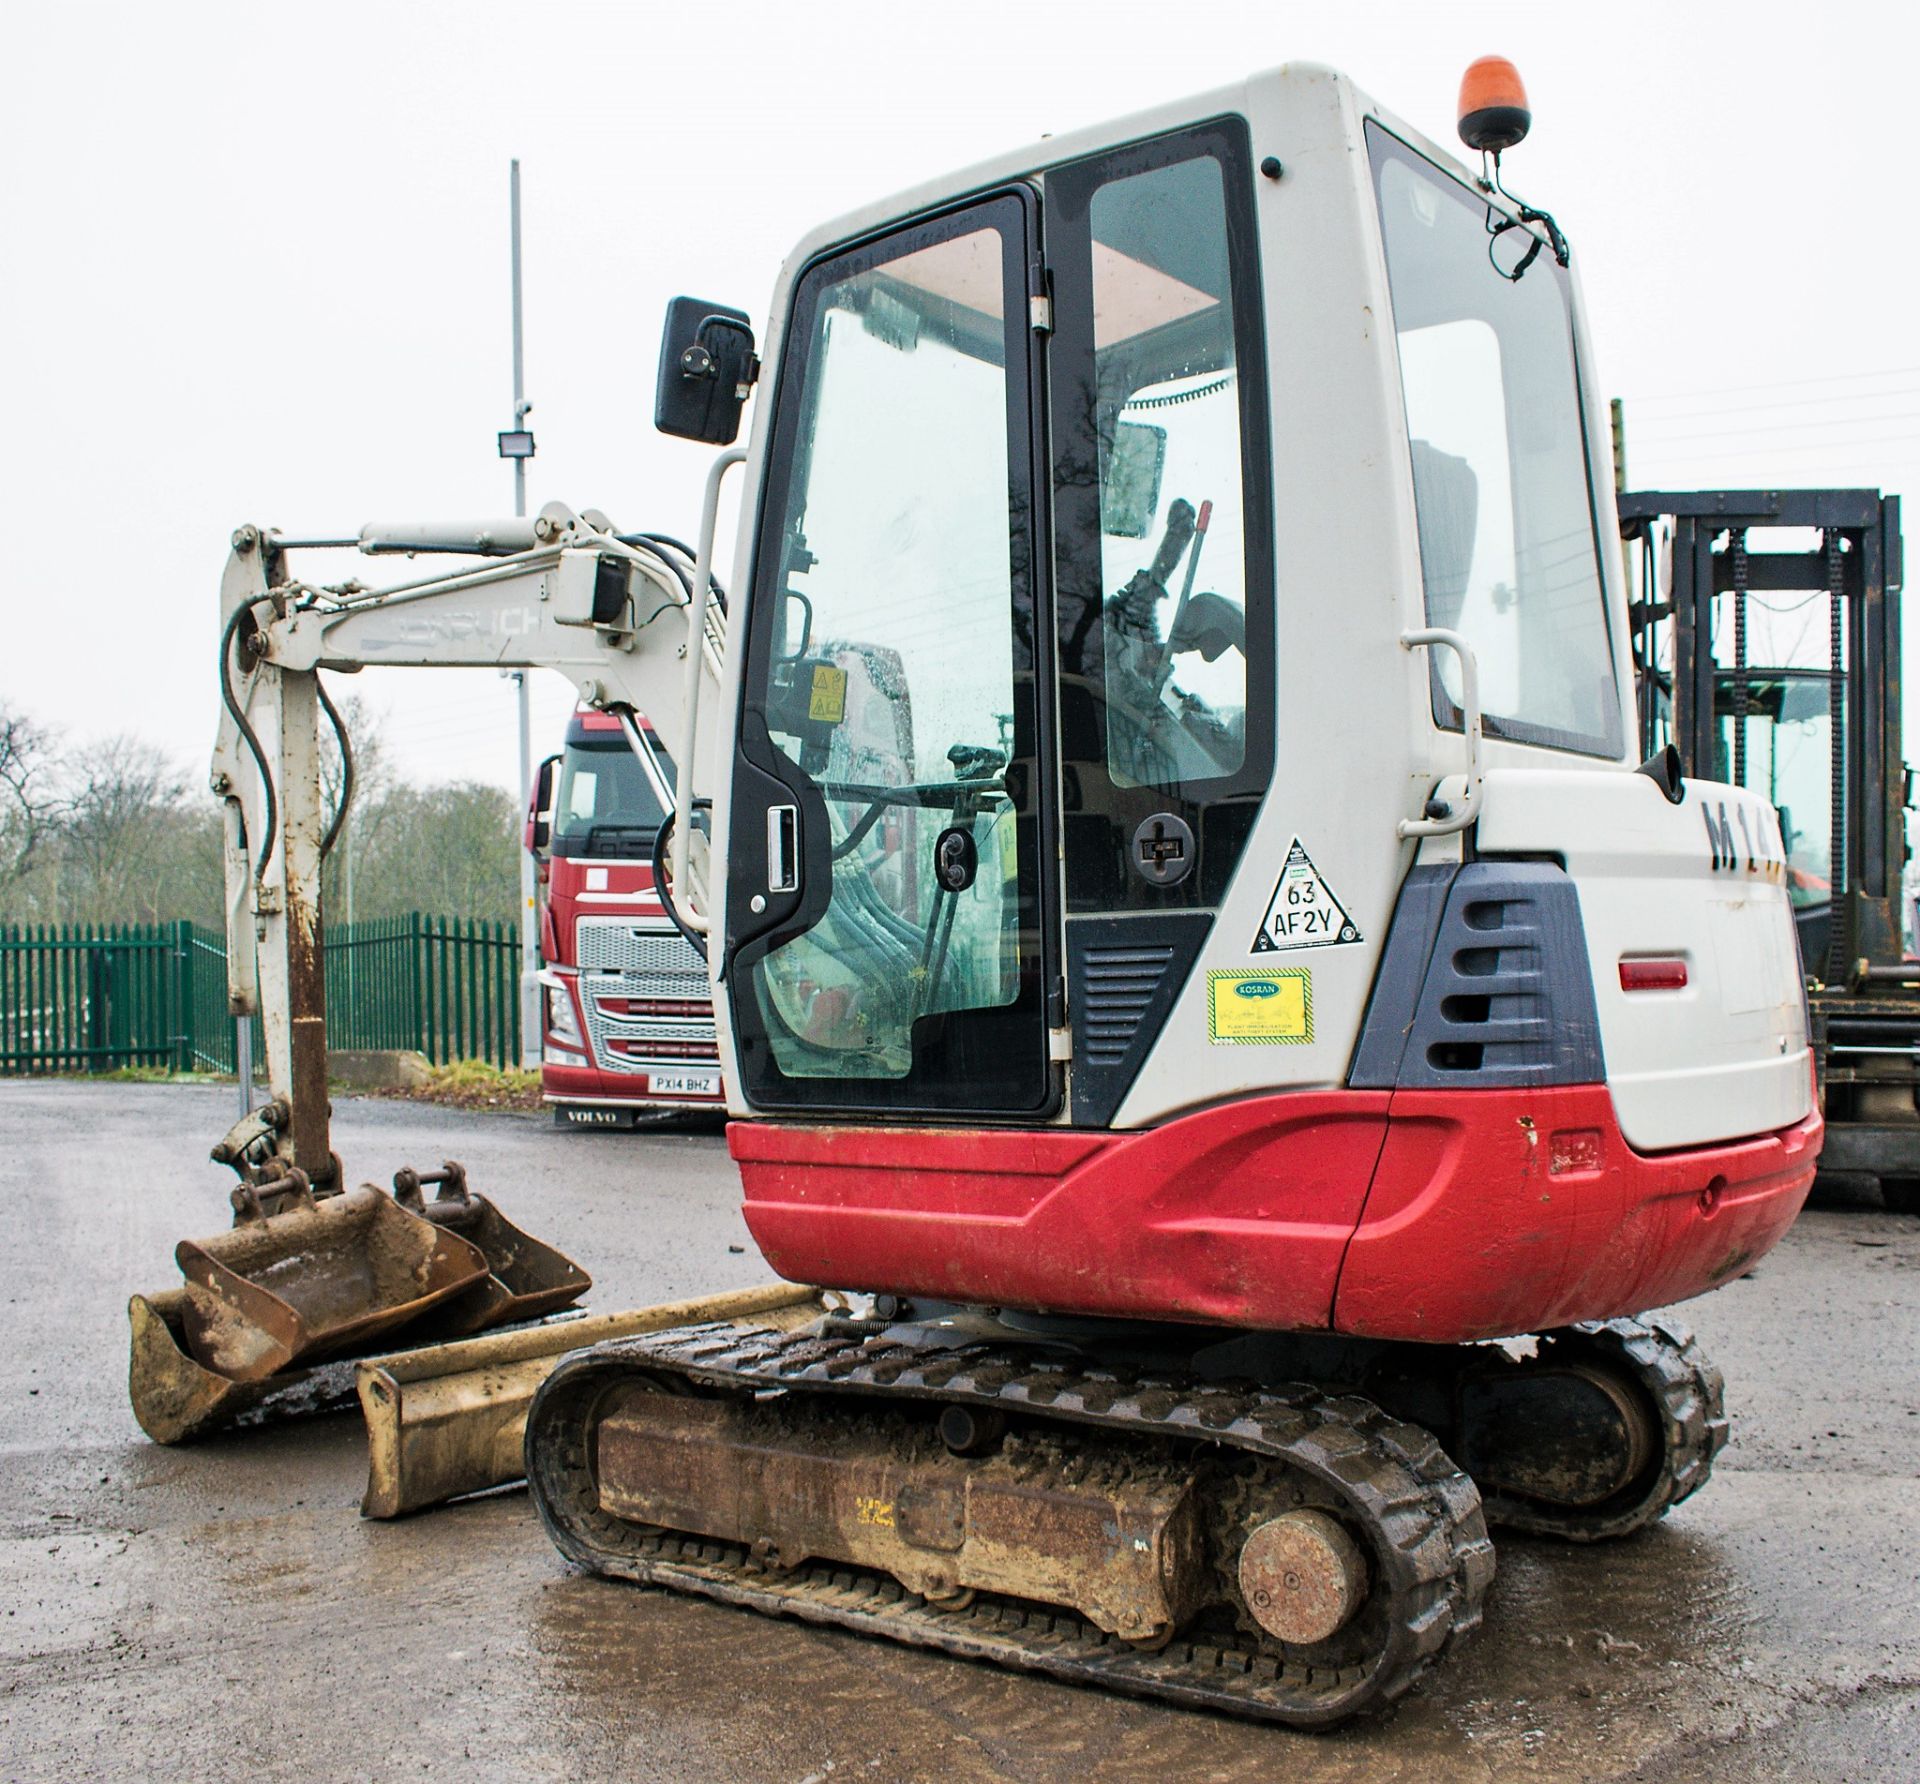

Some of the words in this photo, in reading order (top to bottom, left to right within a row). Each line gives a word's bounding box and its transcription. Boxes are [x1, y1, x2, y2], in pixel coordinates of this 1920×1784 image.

[1288, 881, 1315, 905] 63
[1274, 908, 1331, 936] AF2Y
[1239, 985, 1275, 994] KOSRAN
[657, 1077, 683, 1089] PX14
[687, 1079, 710, 1091] BHZ
[567, 1111, 617, 1123] VOLVO
